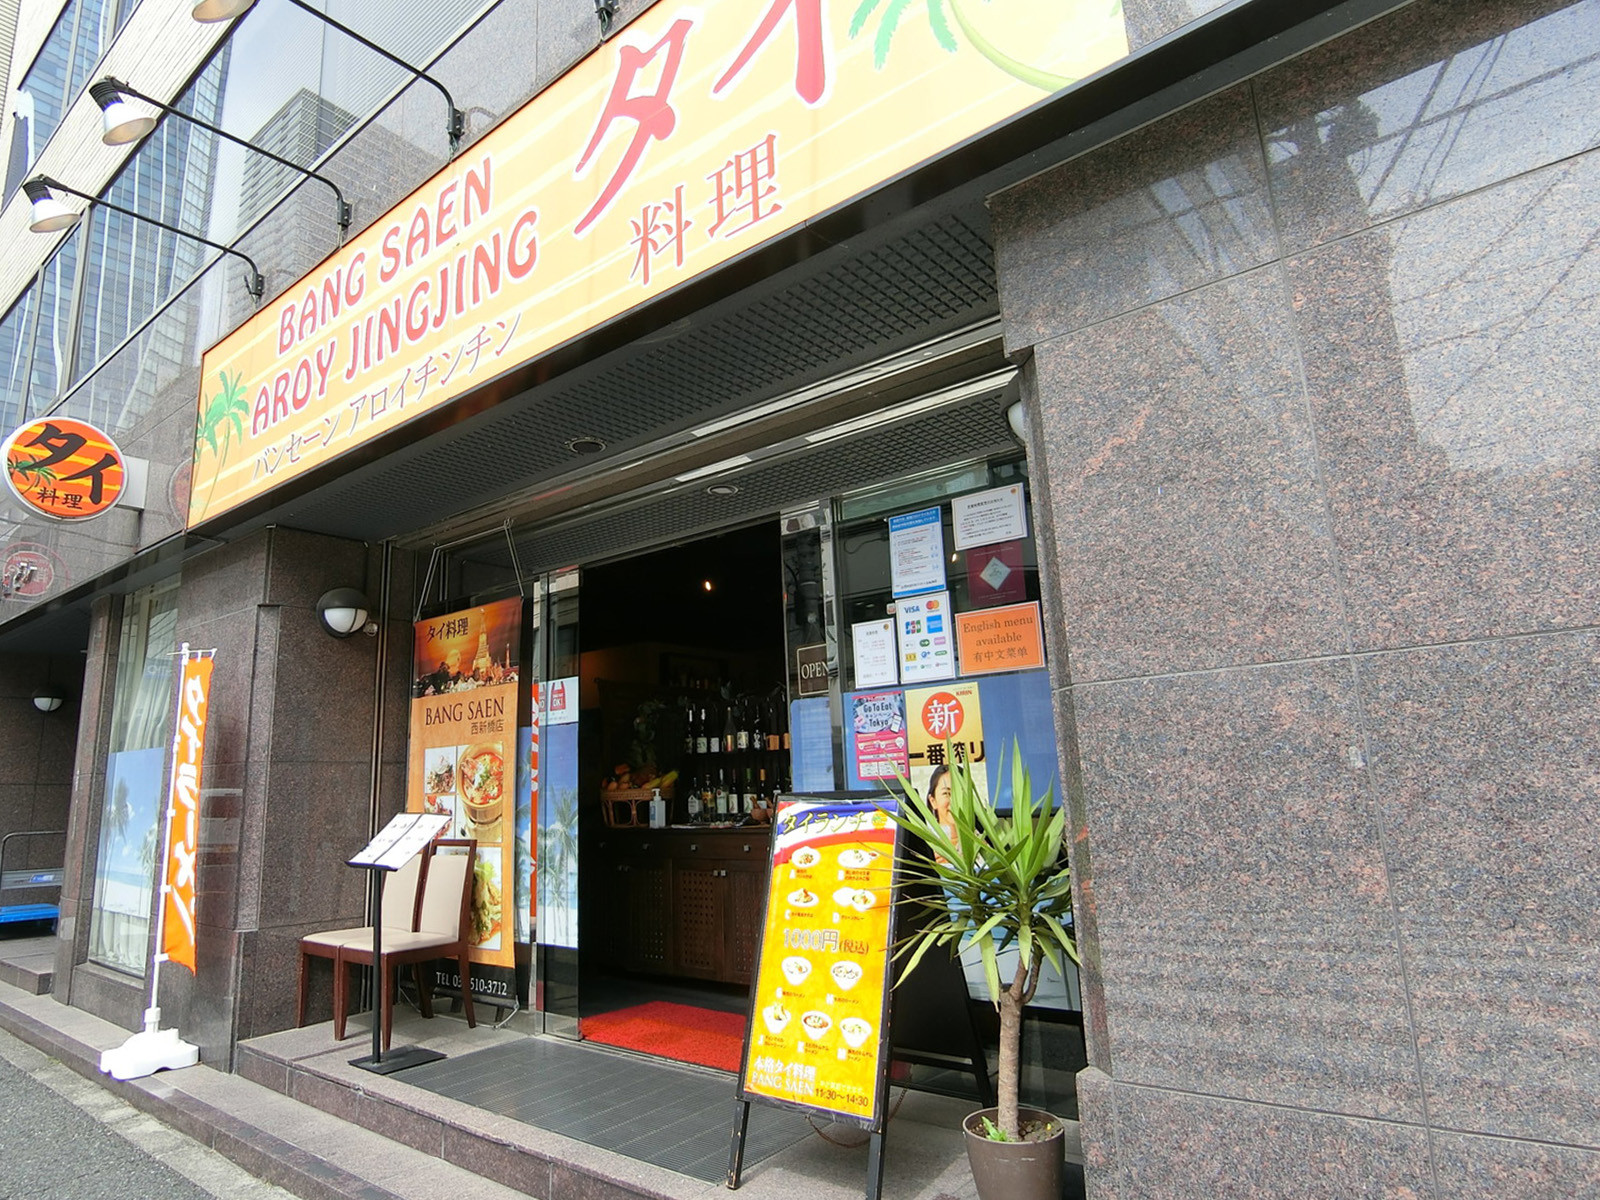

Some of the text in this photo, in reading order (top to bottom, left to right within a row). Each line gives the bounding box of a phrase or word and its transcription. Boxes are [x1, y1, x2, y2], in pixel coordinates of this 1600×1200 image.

[630, 134, 782, 285] 料理
[279, 157, 491, 355] BANG SAEN
[252, 211, 537, 436] AROY JINGJING
[253, 312, 521, 480] バンセーン アロイチンチン
[20, 423, 118, 505] タイ
[37, 487, 83, 510] 料理
[904, 605, 920, 614] VISA
[427, 617, 469, 643] タイ料理
[963, 616, 1033, 633] English menu
[976, 632, 1022, 646] available
[973, 646, 1028, 662] 有中文菜单
[425, 697, 505, 726] BANG SAEN
[863, 702, 893, 713] Go To Eat
[927, 699, 959, 735] 新
[471, 719, 504, 735] 西新橋店
[869, 719, 889, 727] Tokyo
[783, 811, 867, 835] タイランチ
[436, 971, 507, 996] TEL 03510-3712
[754, 1055, 816, 1081] 本格タイ料理
[785, 1078, 815, 1096] SAEN
